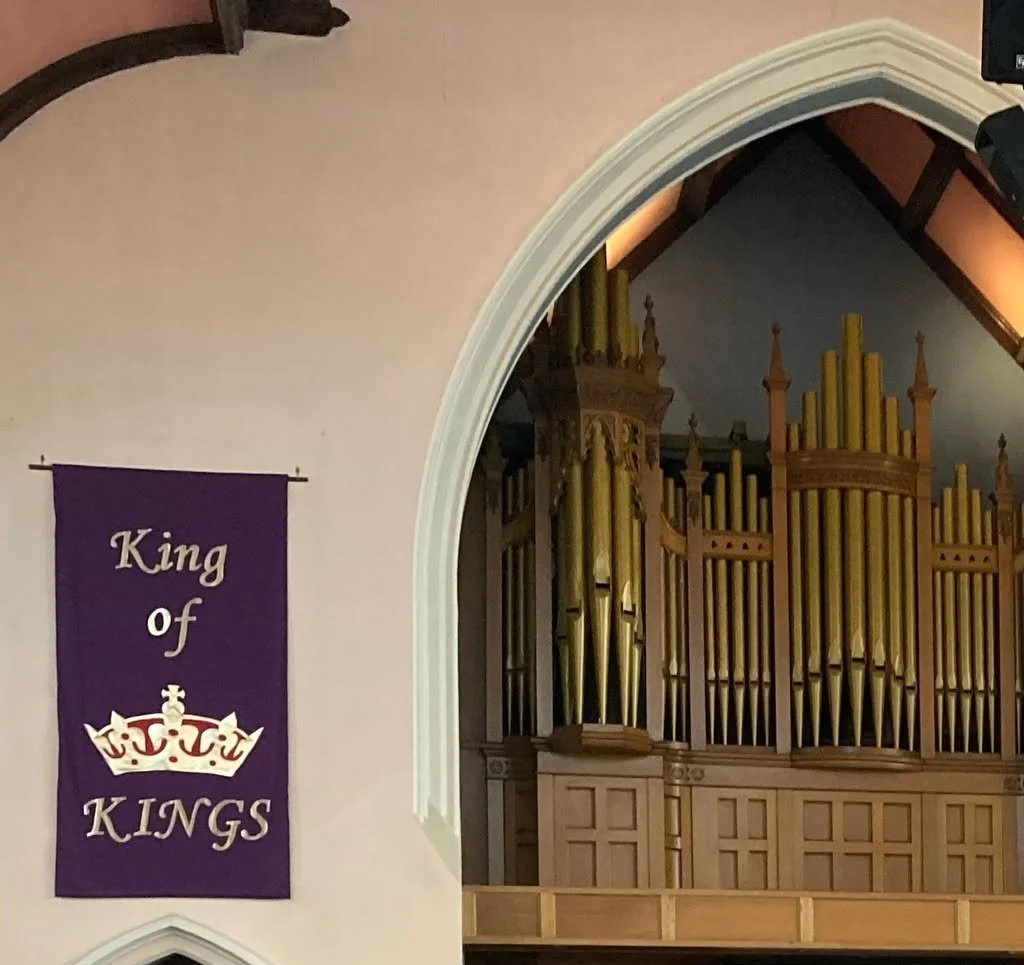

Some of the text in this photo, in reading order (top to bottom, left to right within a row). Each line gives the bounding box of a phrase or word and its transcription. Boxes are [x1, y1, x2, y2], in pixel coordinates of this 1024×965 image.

[110, 527, 228, 588] King
[147, 597, 203, 658] of
[83, 796, 272, 852] KINGS
